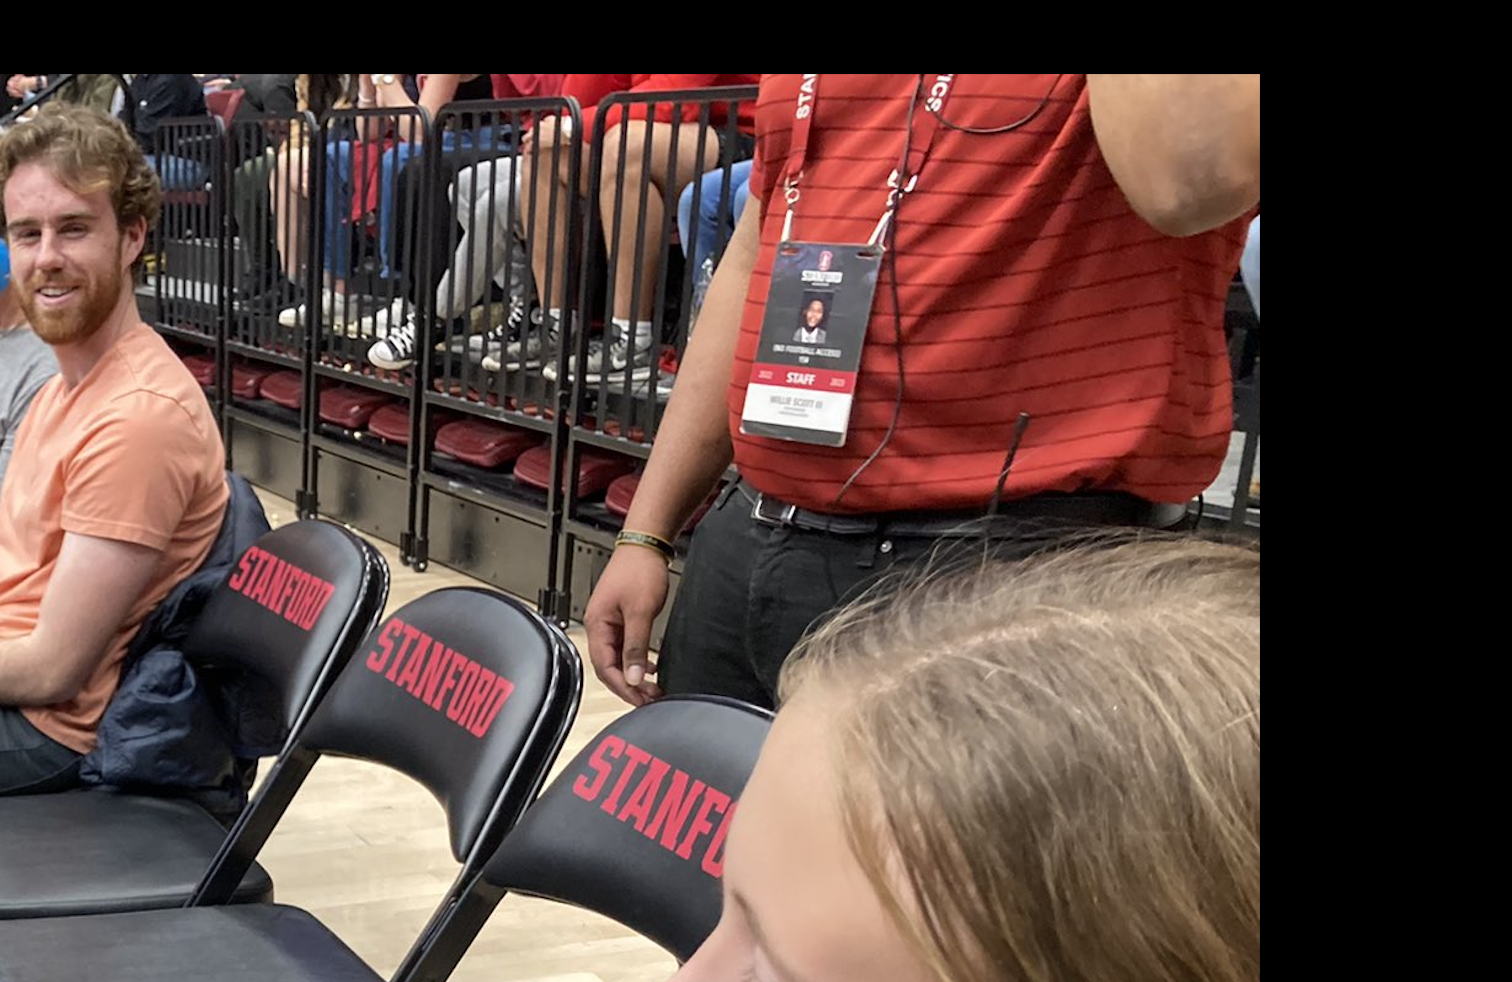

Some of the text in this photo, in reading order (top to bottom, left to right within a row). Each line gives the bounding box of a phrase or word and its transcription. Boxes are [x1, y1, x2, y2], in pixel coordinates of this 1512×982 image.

[925, 74, 953, 112] ICS
[786, 372, 816, 386] STAFF
[229, 546, 335, 631] STANFORD
[366, 617, 515, 739] STANFORD
